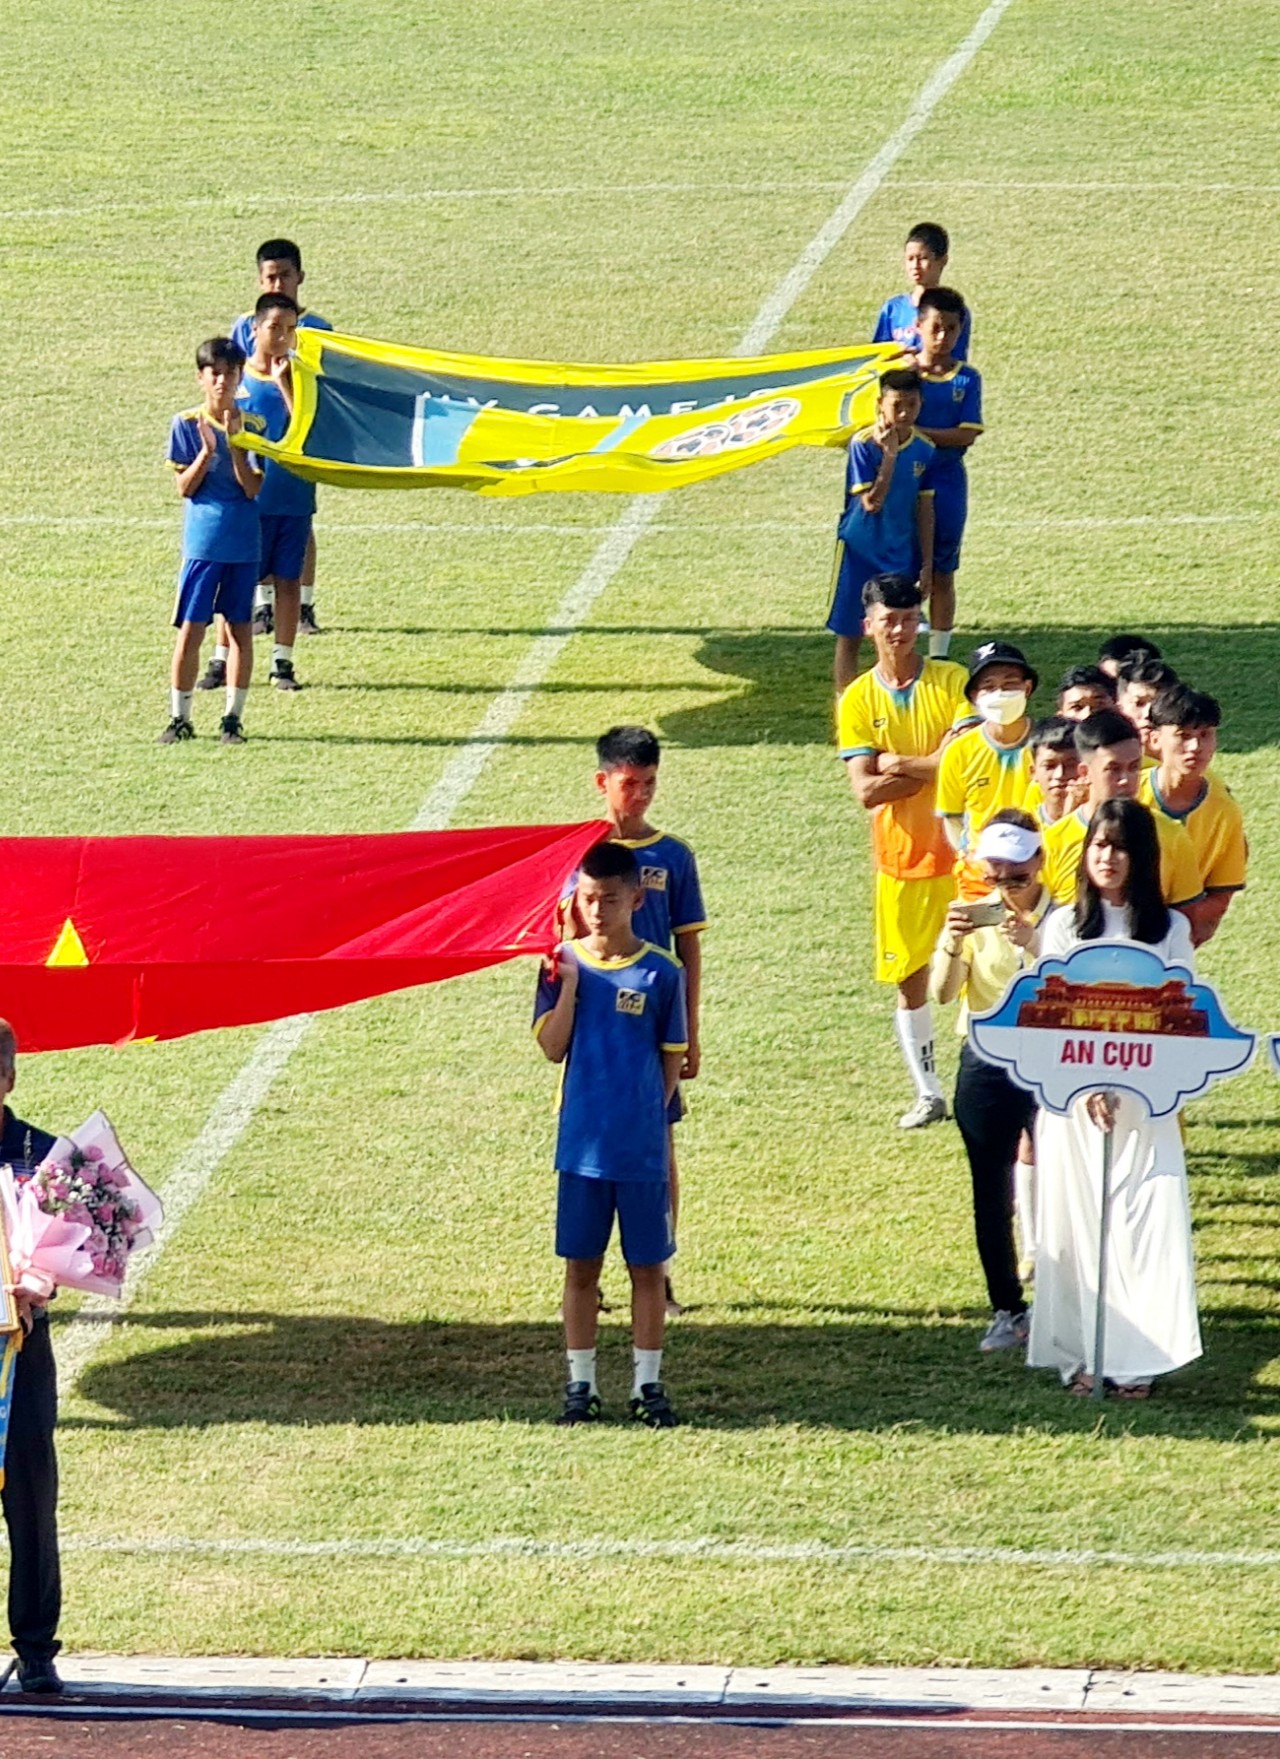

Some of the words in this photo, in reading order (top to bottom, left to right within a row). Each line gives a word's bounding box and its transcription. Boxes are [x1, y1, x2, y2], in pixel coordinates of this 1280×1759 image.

[527, 401, 698, 418] GAME
[1060, 1038, 1095, 1065] AN
[1102, 1040, 1153, 1071] CỰU
